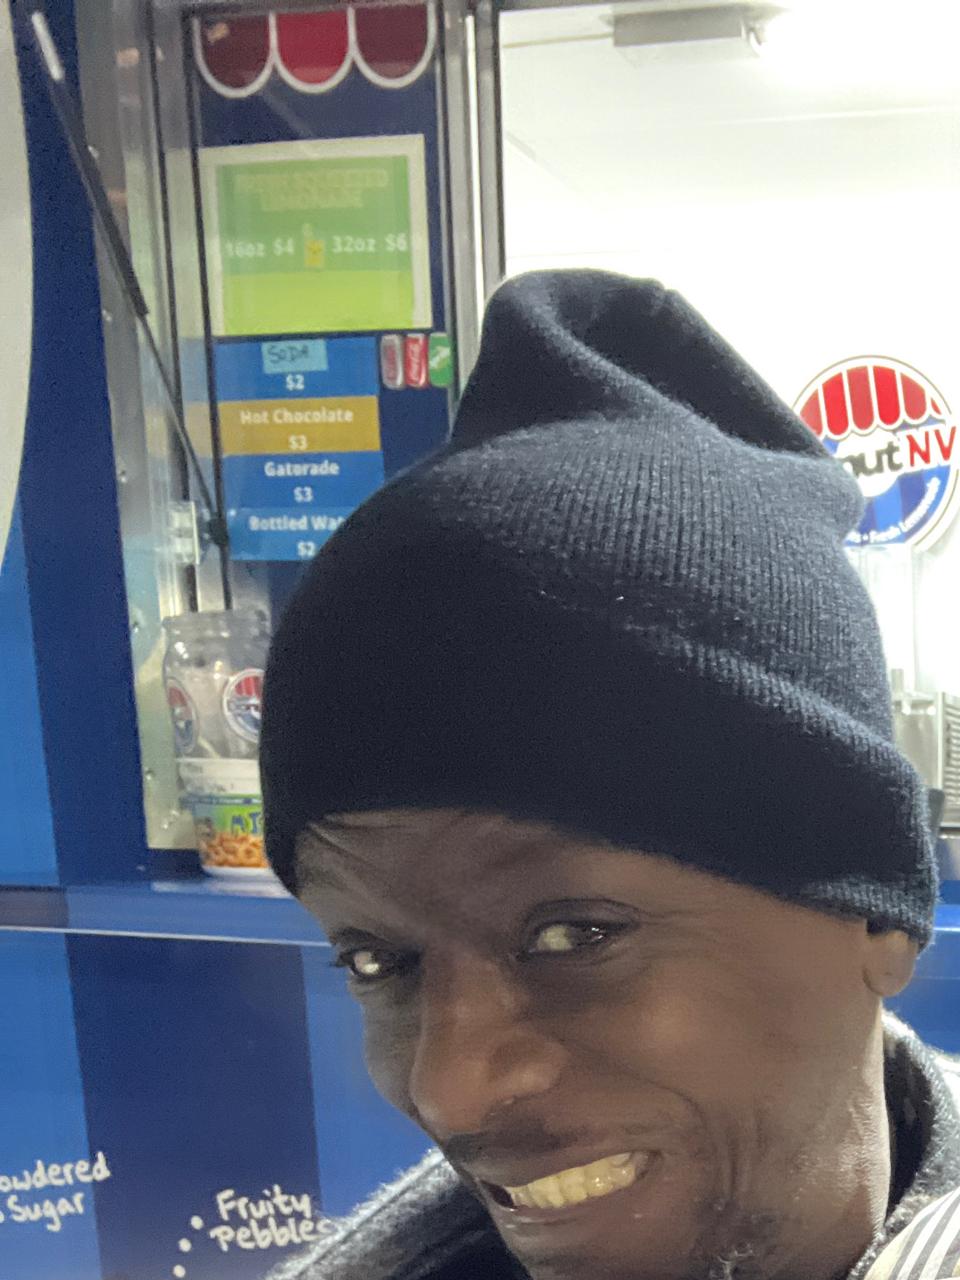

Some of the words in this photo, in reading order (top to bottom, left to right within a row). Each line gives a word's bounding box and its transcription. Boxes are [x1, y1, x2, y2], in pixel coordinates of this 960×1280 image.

[286, 374, 304, 391] $2
[240, 410, 269, 424] Hot
[273, 407, 353, 423] Chocolate
[288, 435, 308, 451] $3
[264, 460, 340, 477] Gatorade
[293, 486, 314, 503] $3
[249, 516, 309, 531] Bottled
[0, 1151, 112, 1191] owdered
[216, 1184, 312, 1221] Fruity
[8, 1192, 85, 1232] Sugar
